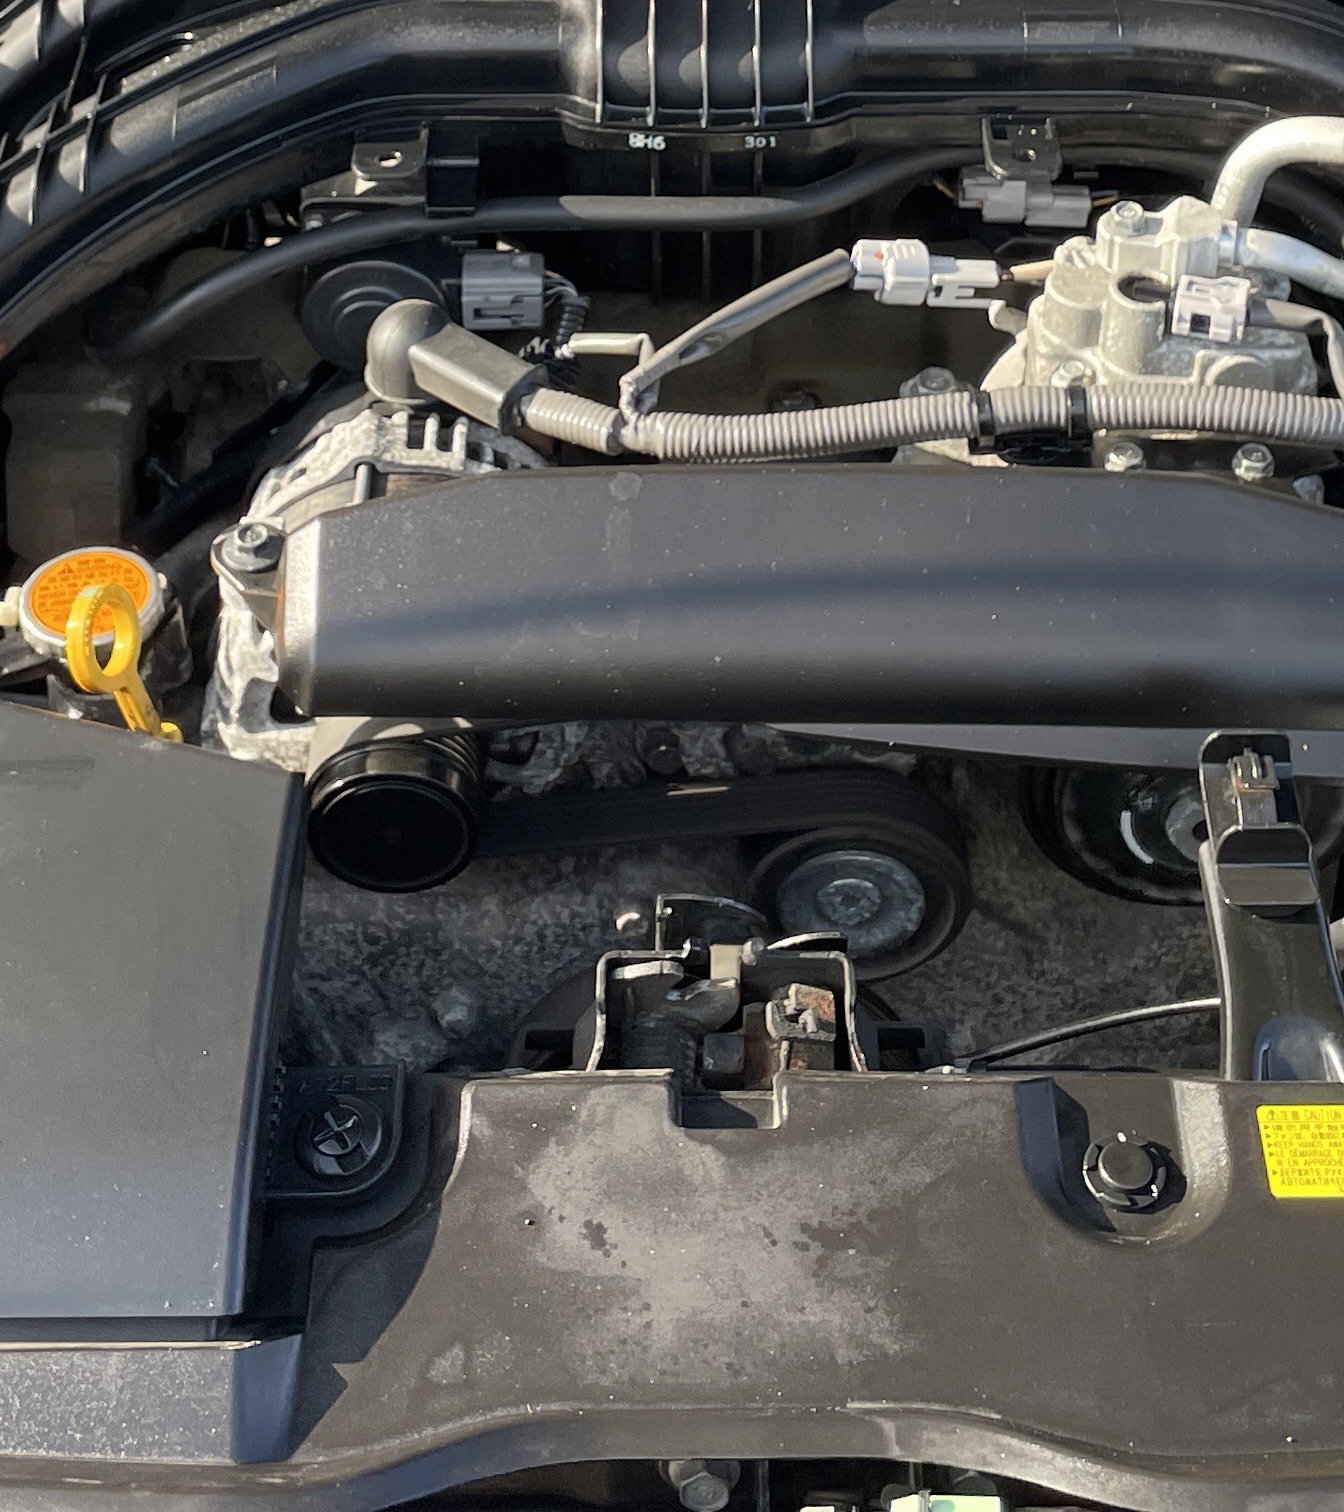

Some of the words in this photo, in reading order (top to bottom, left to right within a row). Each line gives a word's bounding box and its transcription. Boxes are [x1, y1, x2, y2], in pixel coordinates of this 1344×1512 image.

[744, 135, 777, 149] 301
[1304, 1108, 1341, 1122] CAUTION
[1273, 1140, 1294, 1148] KEEP
